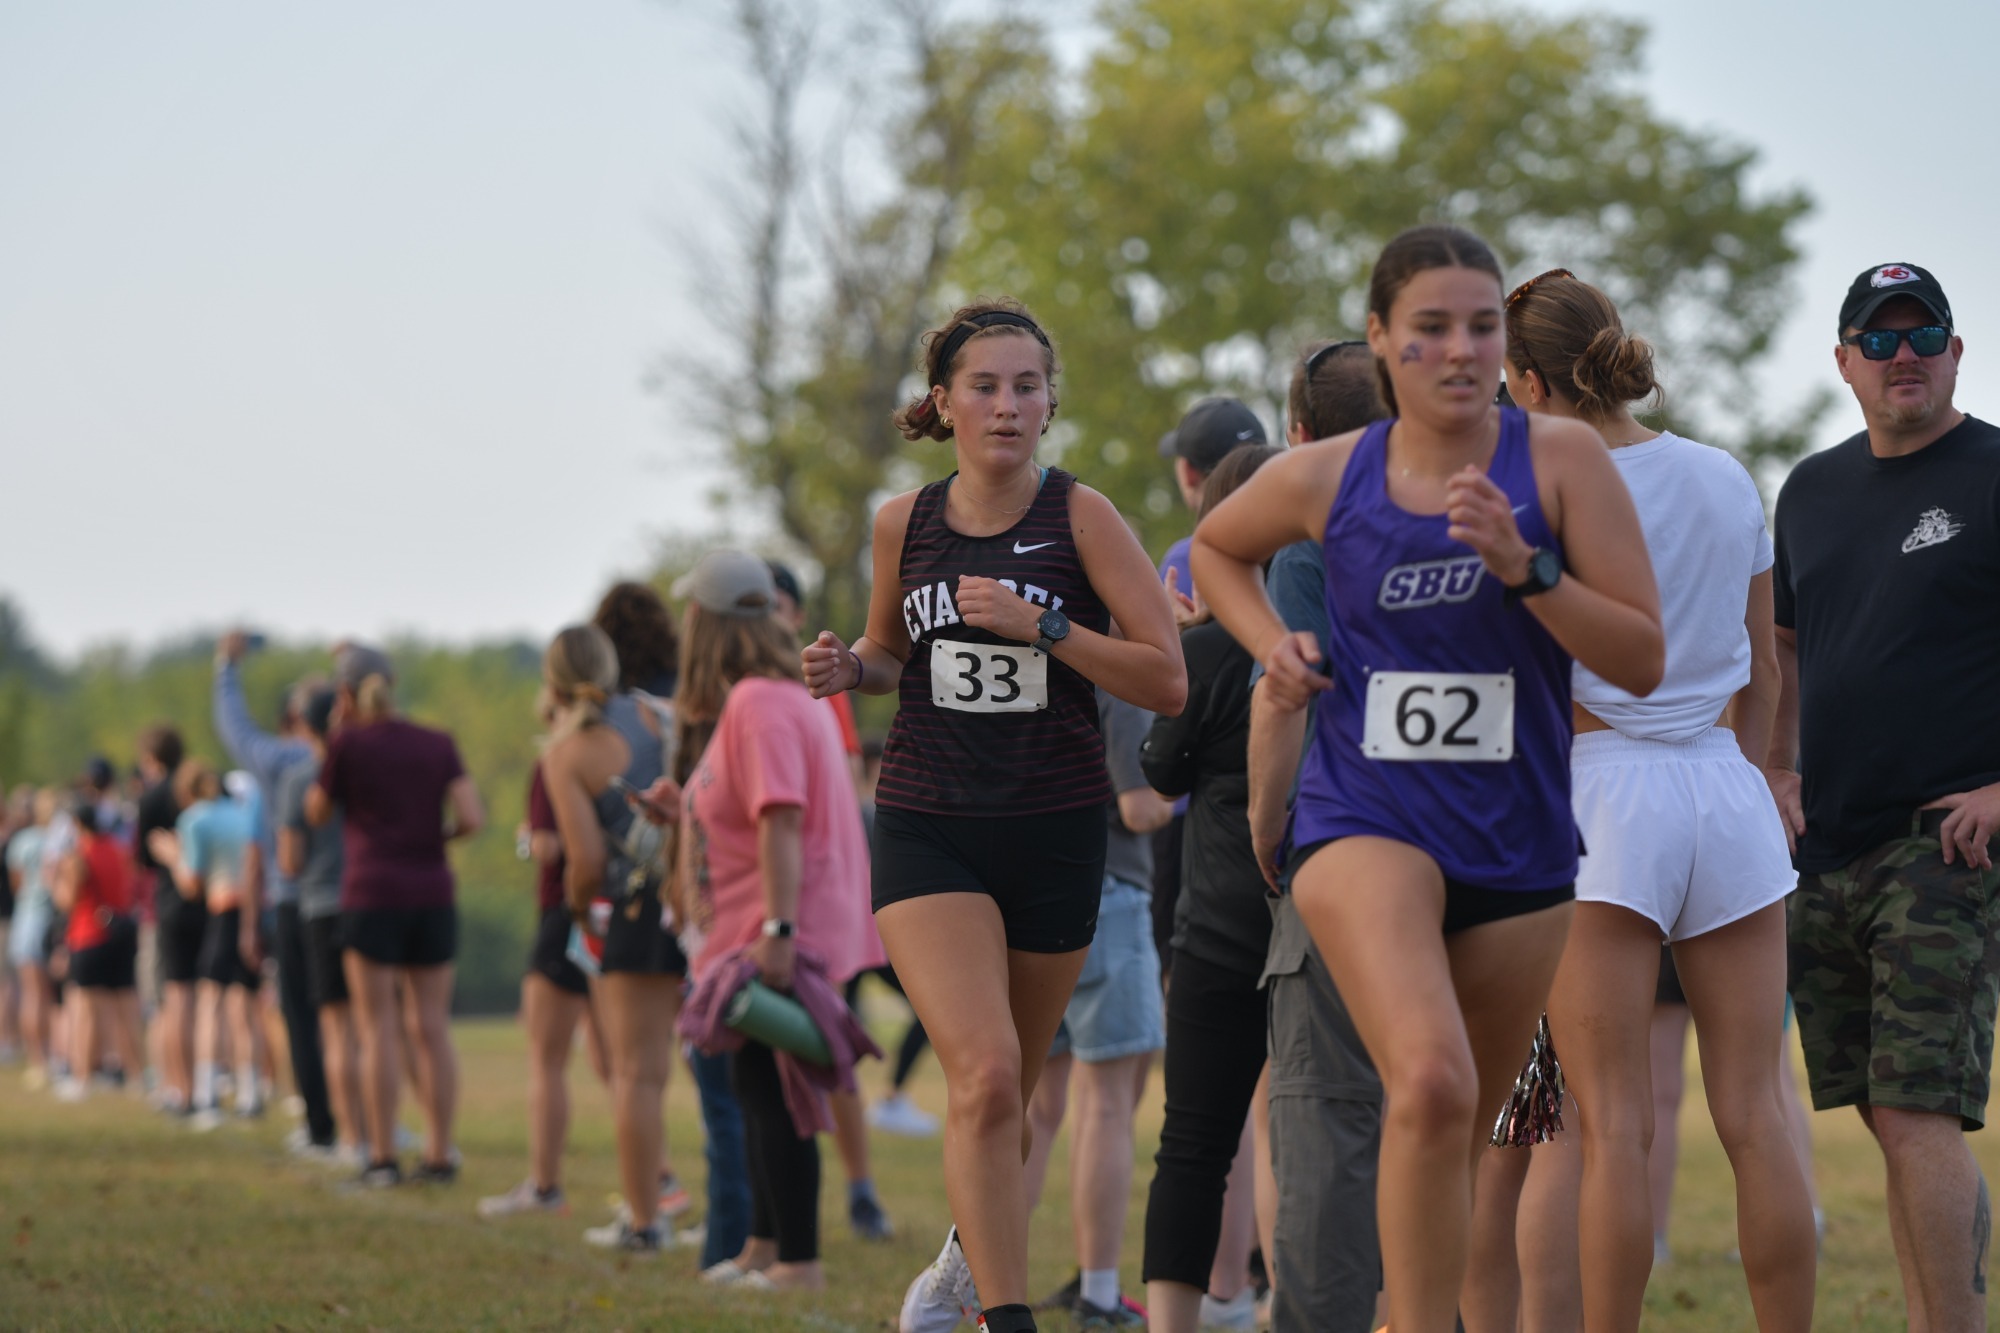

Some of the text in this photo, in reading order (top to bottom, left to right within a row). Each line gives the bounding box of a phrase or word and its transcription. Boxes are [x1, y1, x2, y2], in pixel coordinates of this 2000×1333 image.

[1378, 556, 1487, 610] SBU
[955, 651, 1021, 703] 33
[1395, 685, 1480, 747] 62
